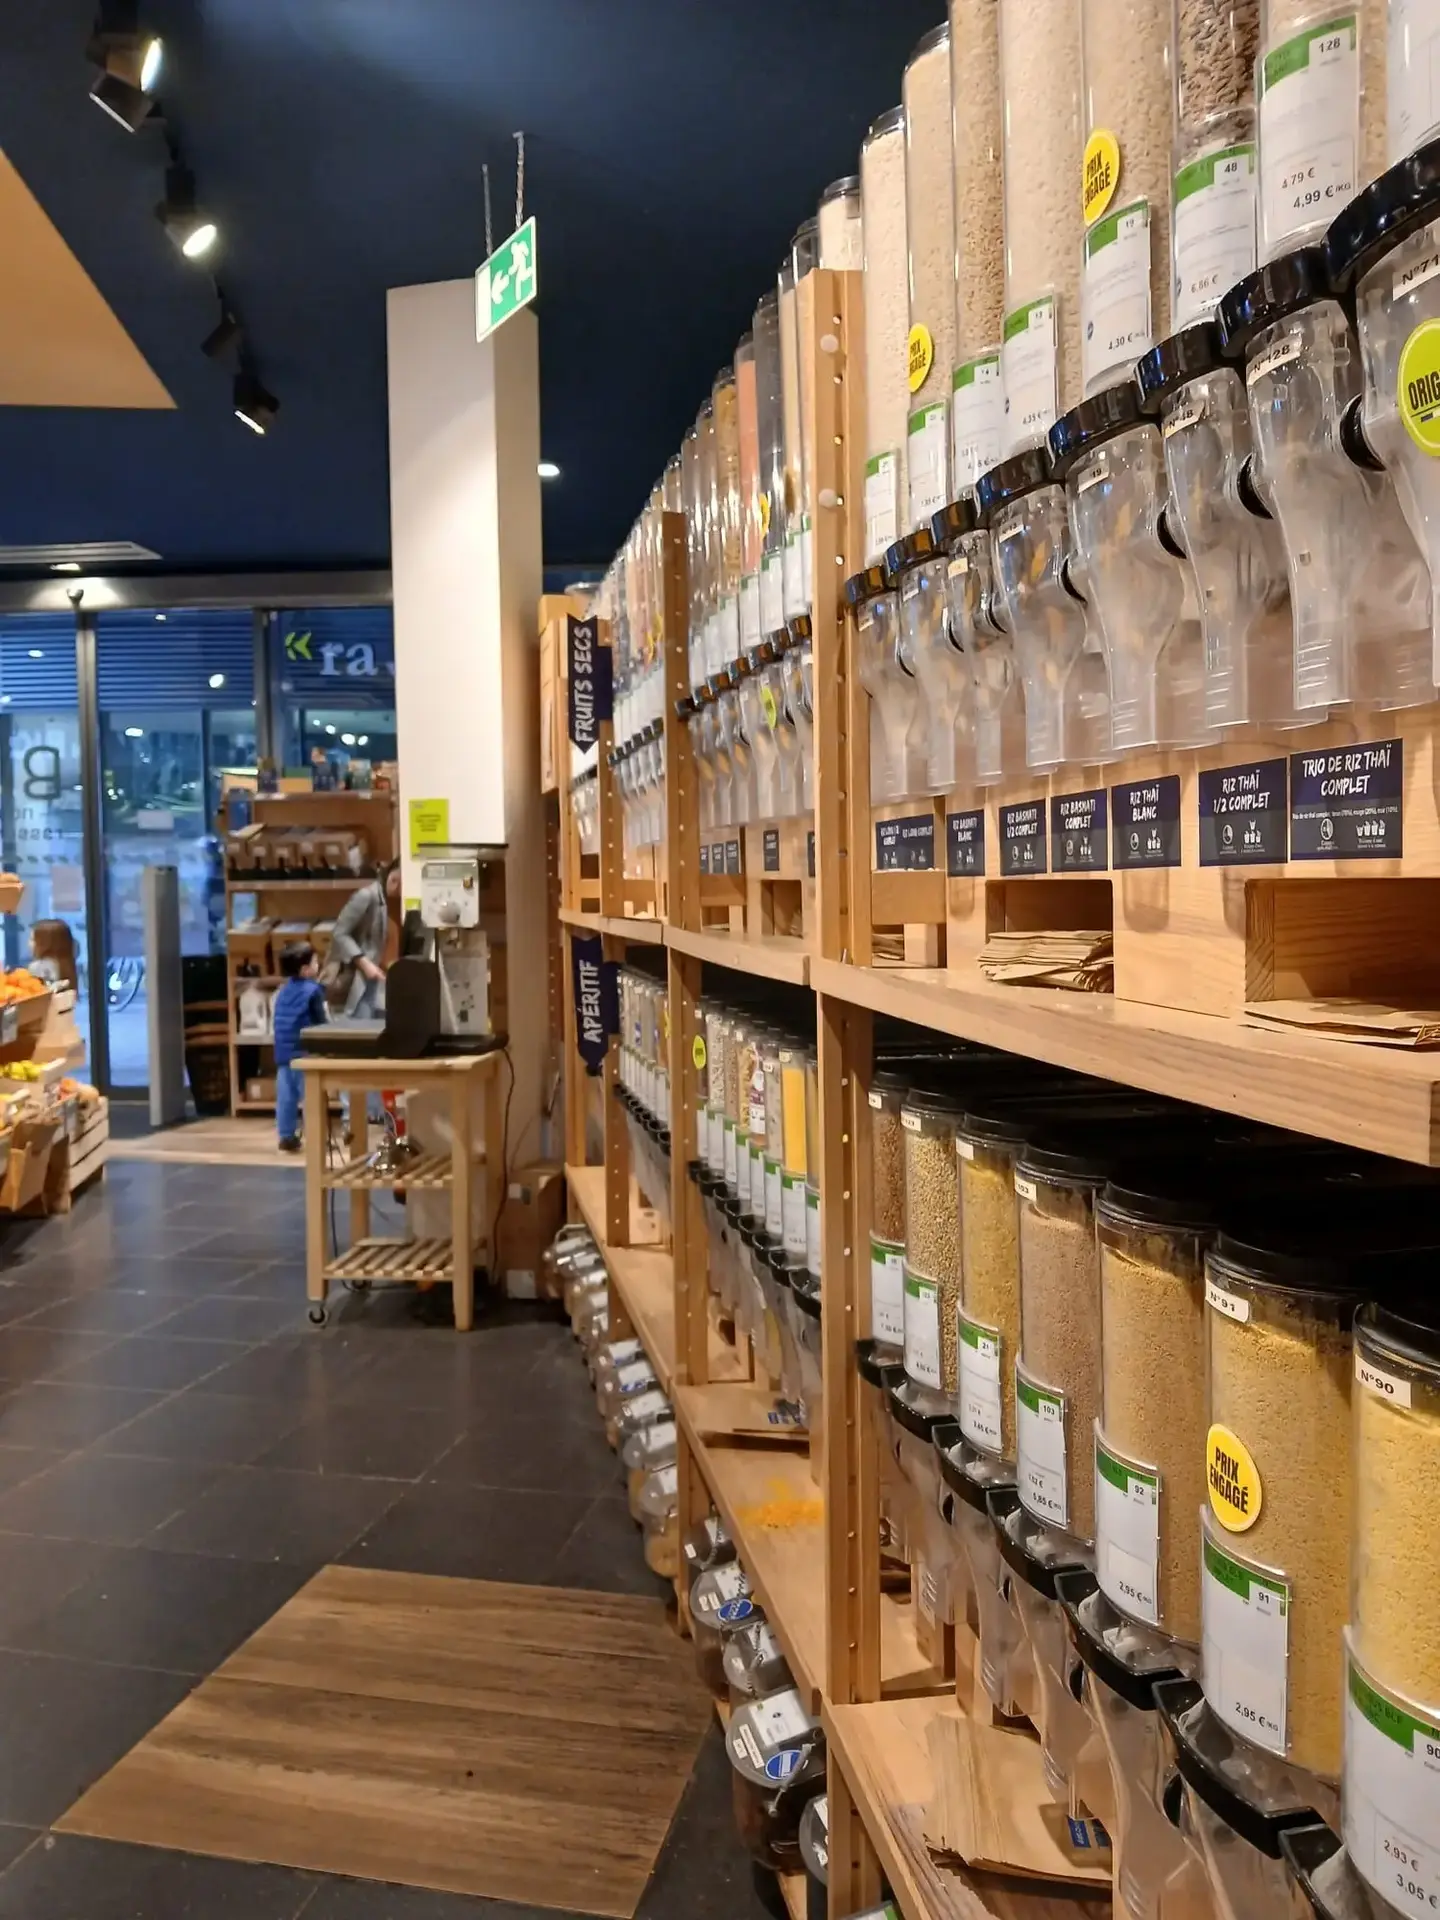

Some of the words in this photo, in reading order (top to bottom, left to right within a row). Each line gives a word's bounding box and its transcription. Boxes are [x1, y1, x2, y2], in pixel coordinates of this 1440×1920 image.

[1319, 37, 1342, 53] 128
[1086, 150, 1102, 183] PRIX
[1224, 162, 1238, 173] 48
[1293, 190, 1321, 209] 4,99
[1408, 369, 1440, 411] ORIG
[320, 642, 393, 676] ra
[574, 627, 593, 675] SECS
[574, 679, 595, 742] FRUITS
[1302, 759, 1325, 778] TRIO
[1328, 755, 1342, 773] DE
[1344, 753, 1361, 771] RIZ
[1364, 744, 1392, 770] THAÏ
[1222, 777, 1236, 794] RIZ
[1239, 769, 1260, 791] THAÏ
[1320, 775, 1371, 796] COMPLET
[1130, 791, 1141, 805] RIZ
[1142, 784, 1160, 802] THAÏ
[1228, 792, 1271, 812] COMPLET
[1060, 802, 1070, 815] RIZ
[1070, 799, 1096, 814] BASMATI
[1132, 806, 1157, 821] BLANC
[1065, 815, 1091, 830] COMPLET
[577, 959, 604, 1043] APÉRITIF
[1210, 1289, 1236, 1312] N°91
[1361, 1369, 1394, 1394] N°90
[1043, 1405, 1055, 1415] 103
[1215, 1446, 1239, 1484] PRIX
[1134, 1485, 1145, 1496] 92
[1209, 1463, 1249, 1514] ENGAGÉ
[1258, 1592, 1269, 1604] 91
[1235, 1702, 1256, 1722] 2,95
[1384, 1839, 1407, 1864] 2,93
[1410, 1859, 1419, 1872] €
[1396, 1874, 1424, 1900] 3,05
[1429, 1895, 1438, 1909] €
